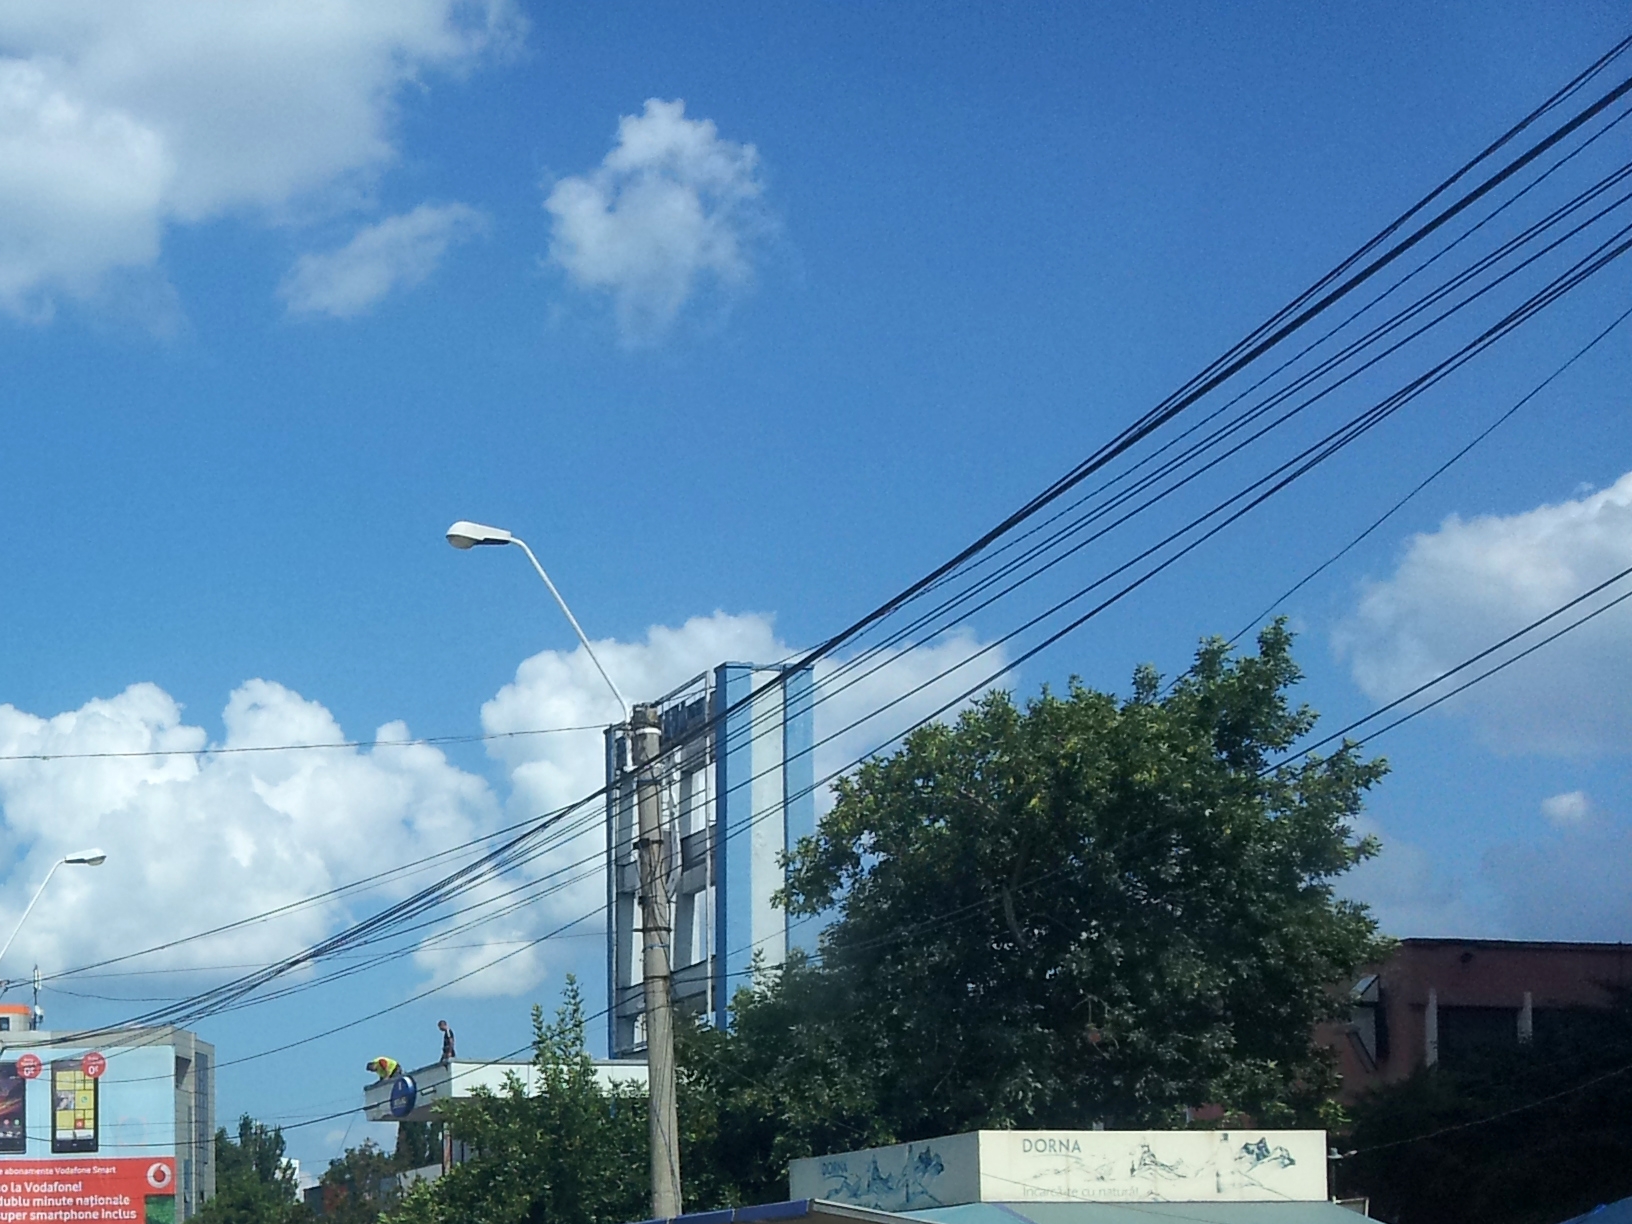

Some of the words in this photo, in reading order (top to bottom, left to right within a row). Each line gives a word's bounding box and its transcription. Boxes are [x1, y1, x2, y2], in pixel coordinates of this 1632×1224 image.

[1023, 1139, 1082, 1153] DORNA
[5, 1167, 54, 1175] abonamente
[55, 1166, 92, 1174] Vodafone
[93, 1166, 116, 1174] Smart
[11, 1182, 22, 1193] la
[24, 1181, 83, 1193] Vodafone!
[33, 1195, 74, 1207] minute
[29, 1209, 99, 1222] smartphone
[101, 1208, 137, 1220] inclus
